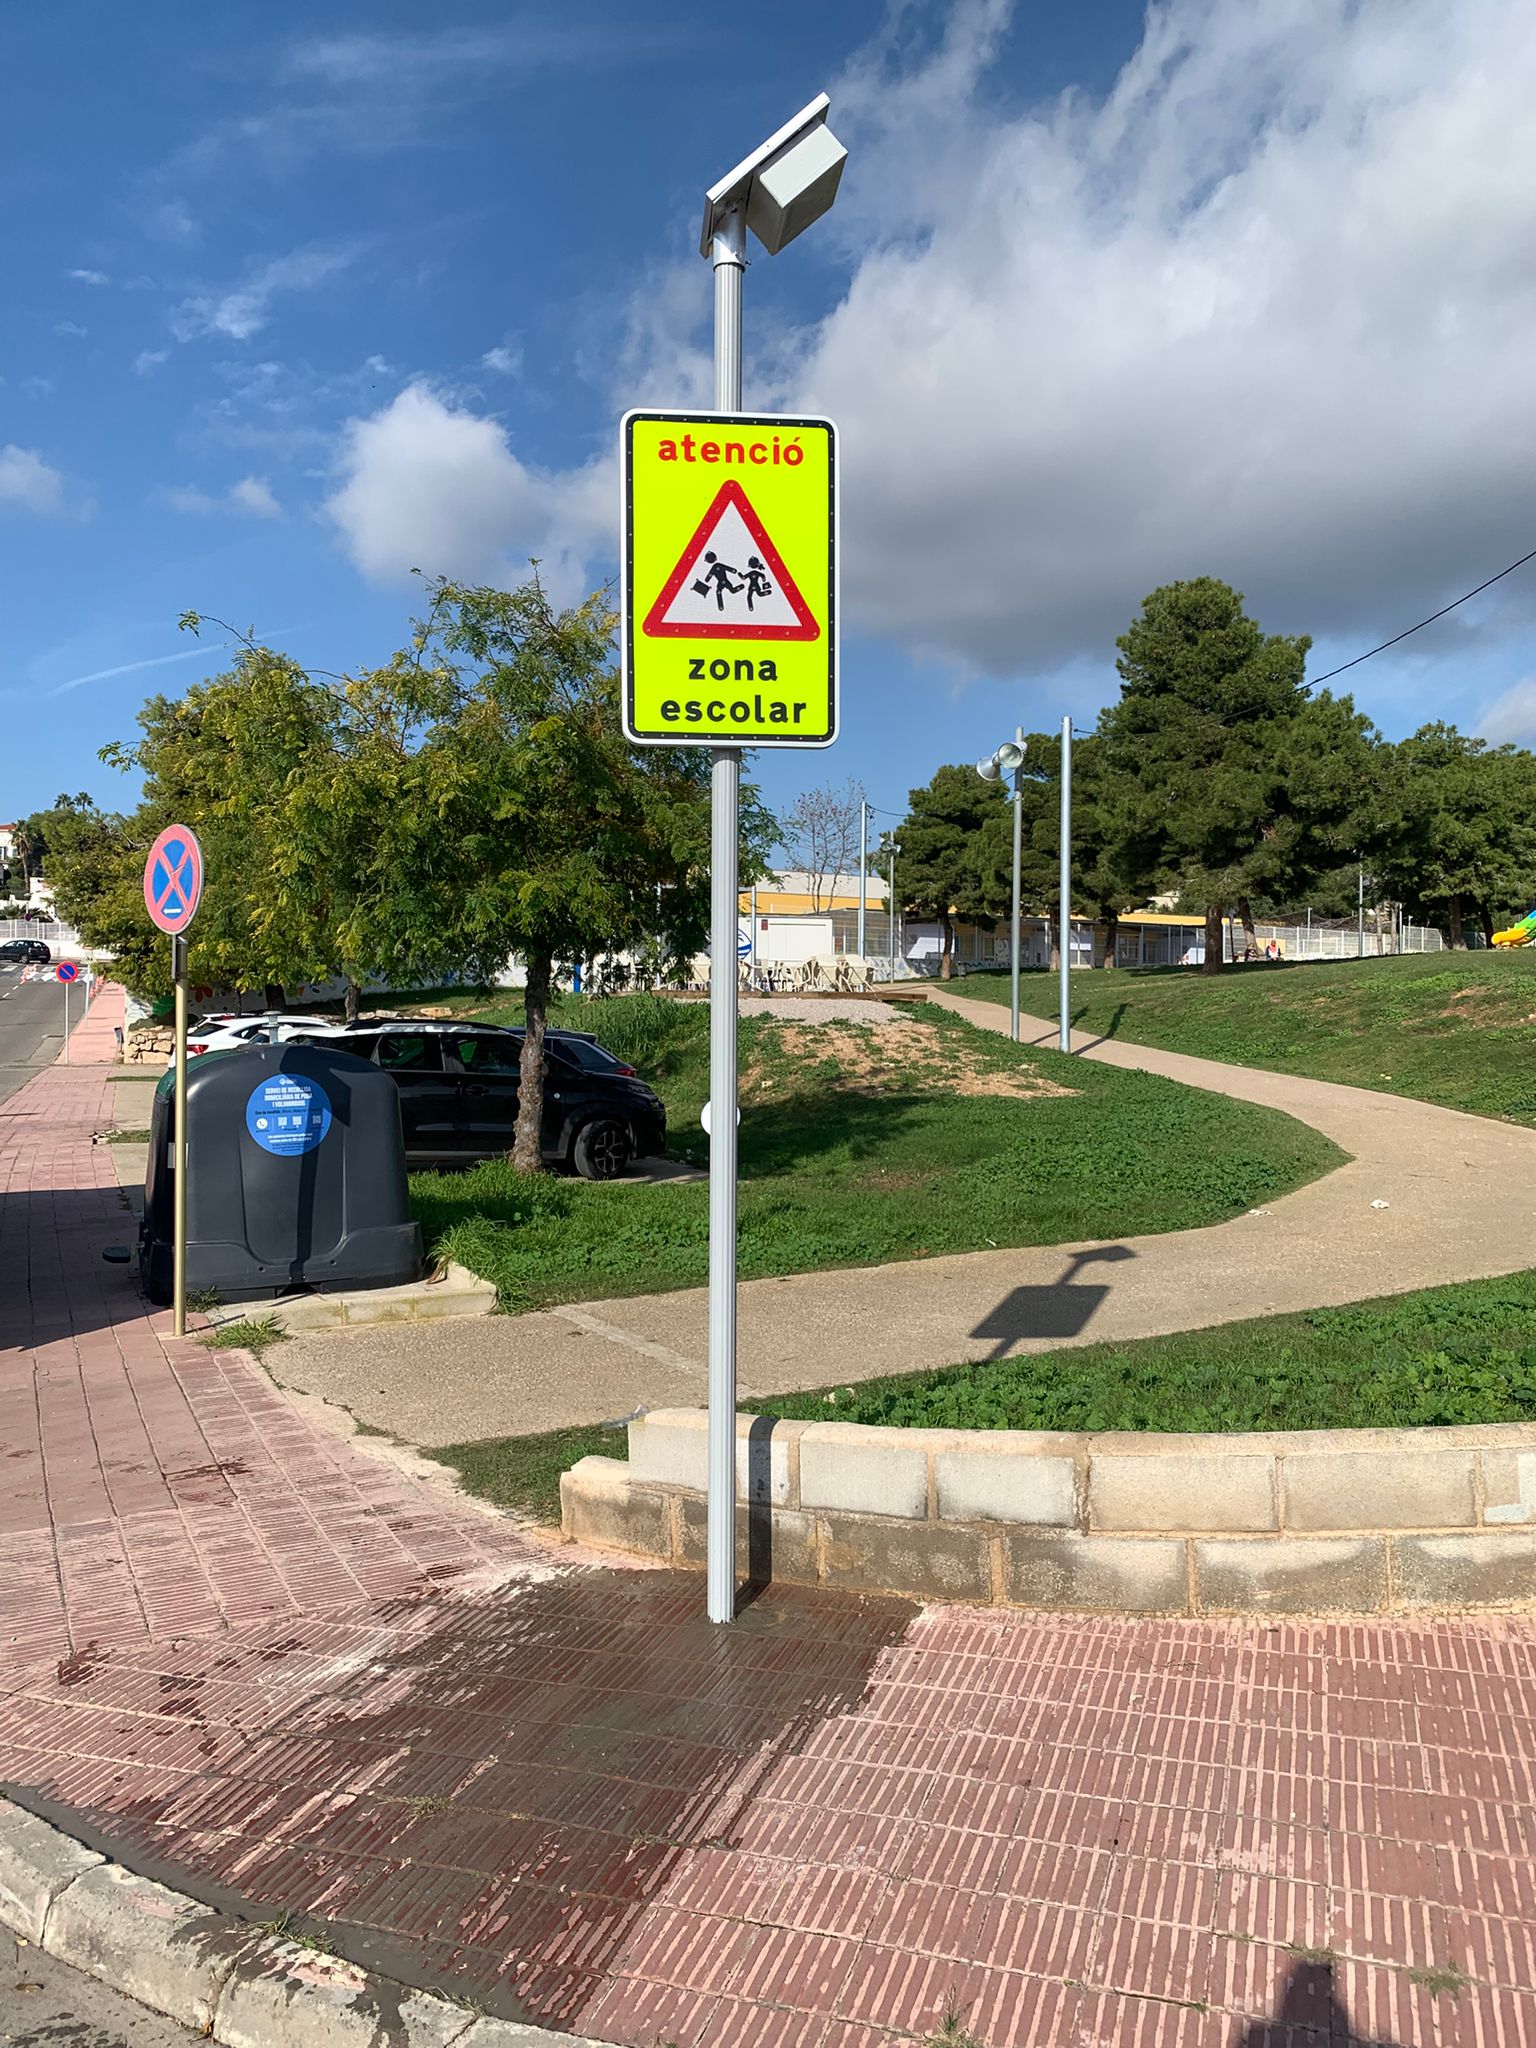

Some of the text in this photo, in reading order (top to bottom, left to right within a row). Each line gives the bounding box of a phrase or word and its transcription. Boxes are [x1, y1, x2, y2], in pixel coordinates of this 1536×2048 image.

[659, 434, 803, 466] atenció
[689, 659, 777, 681] zona
[661, 695, 806, 723] escolar
